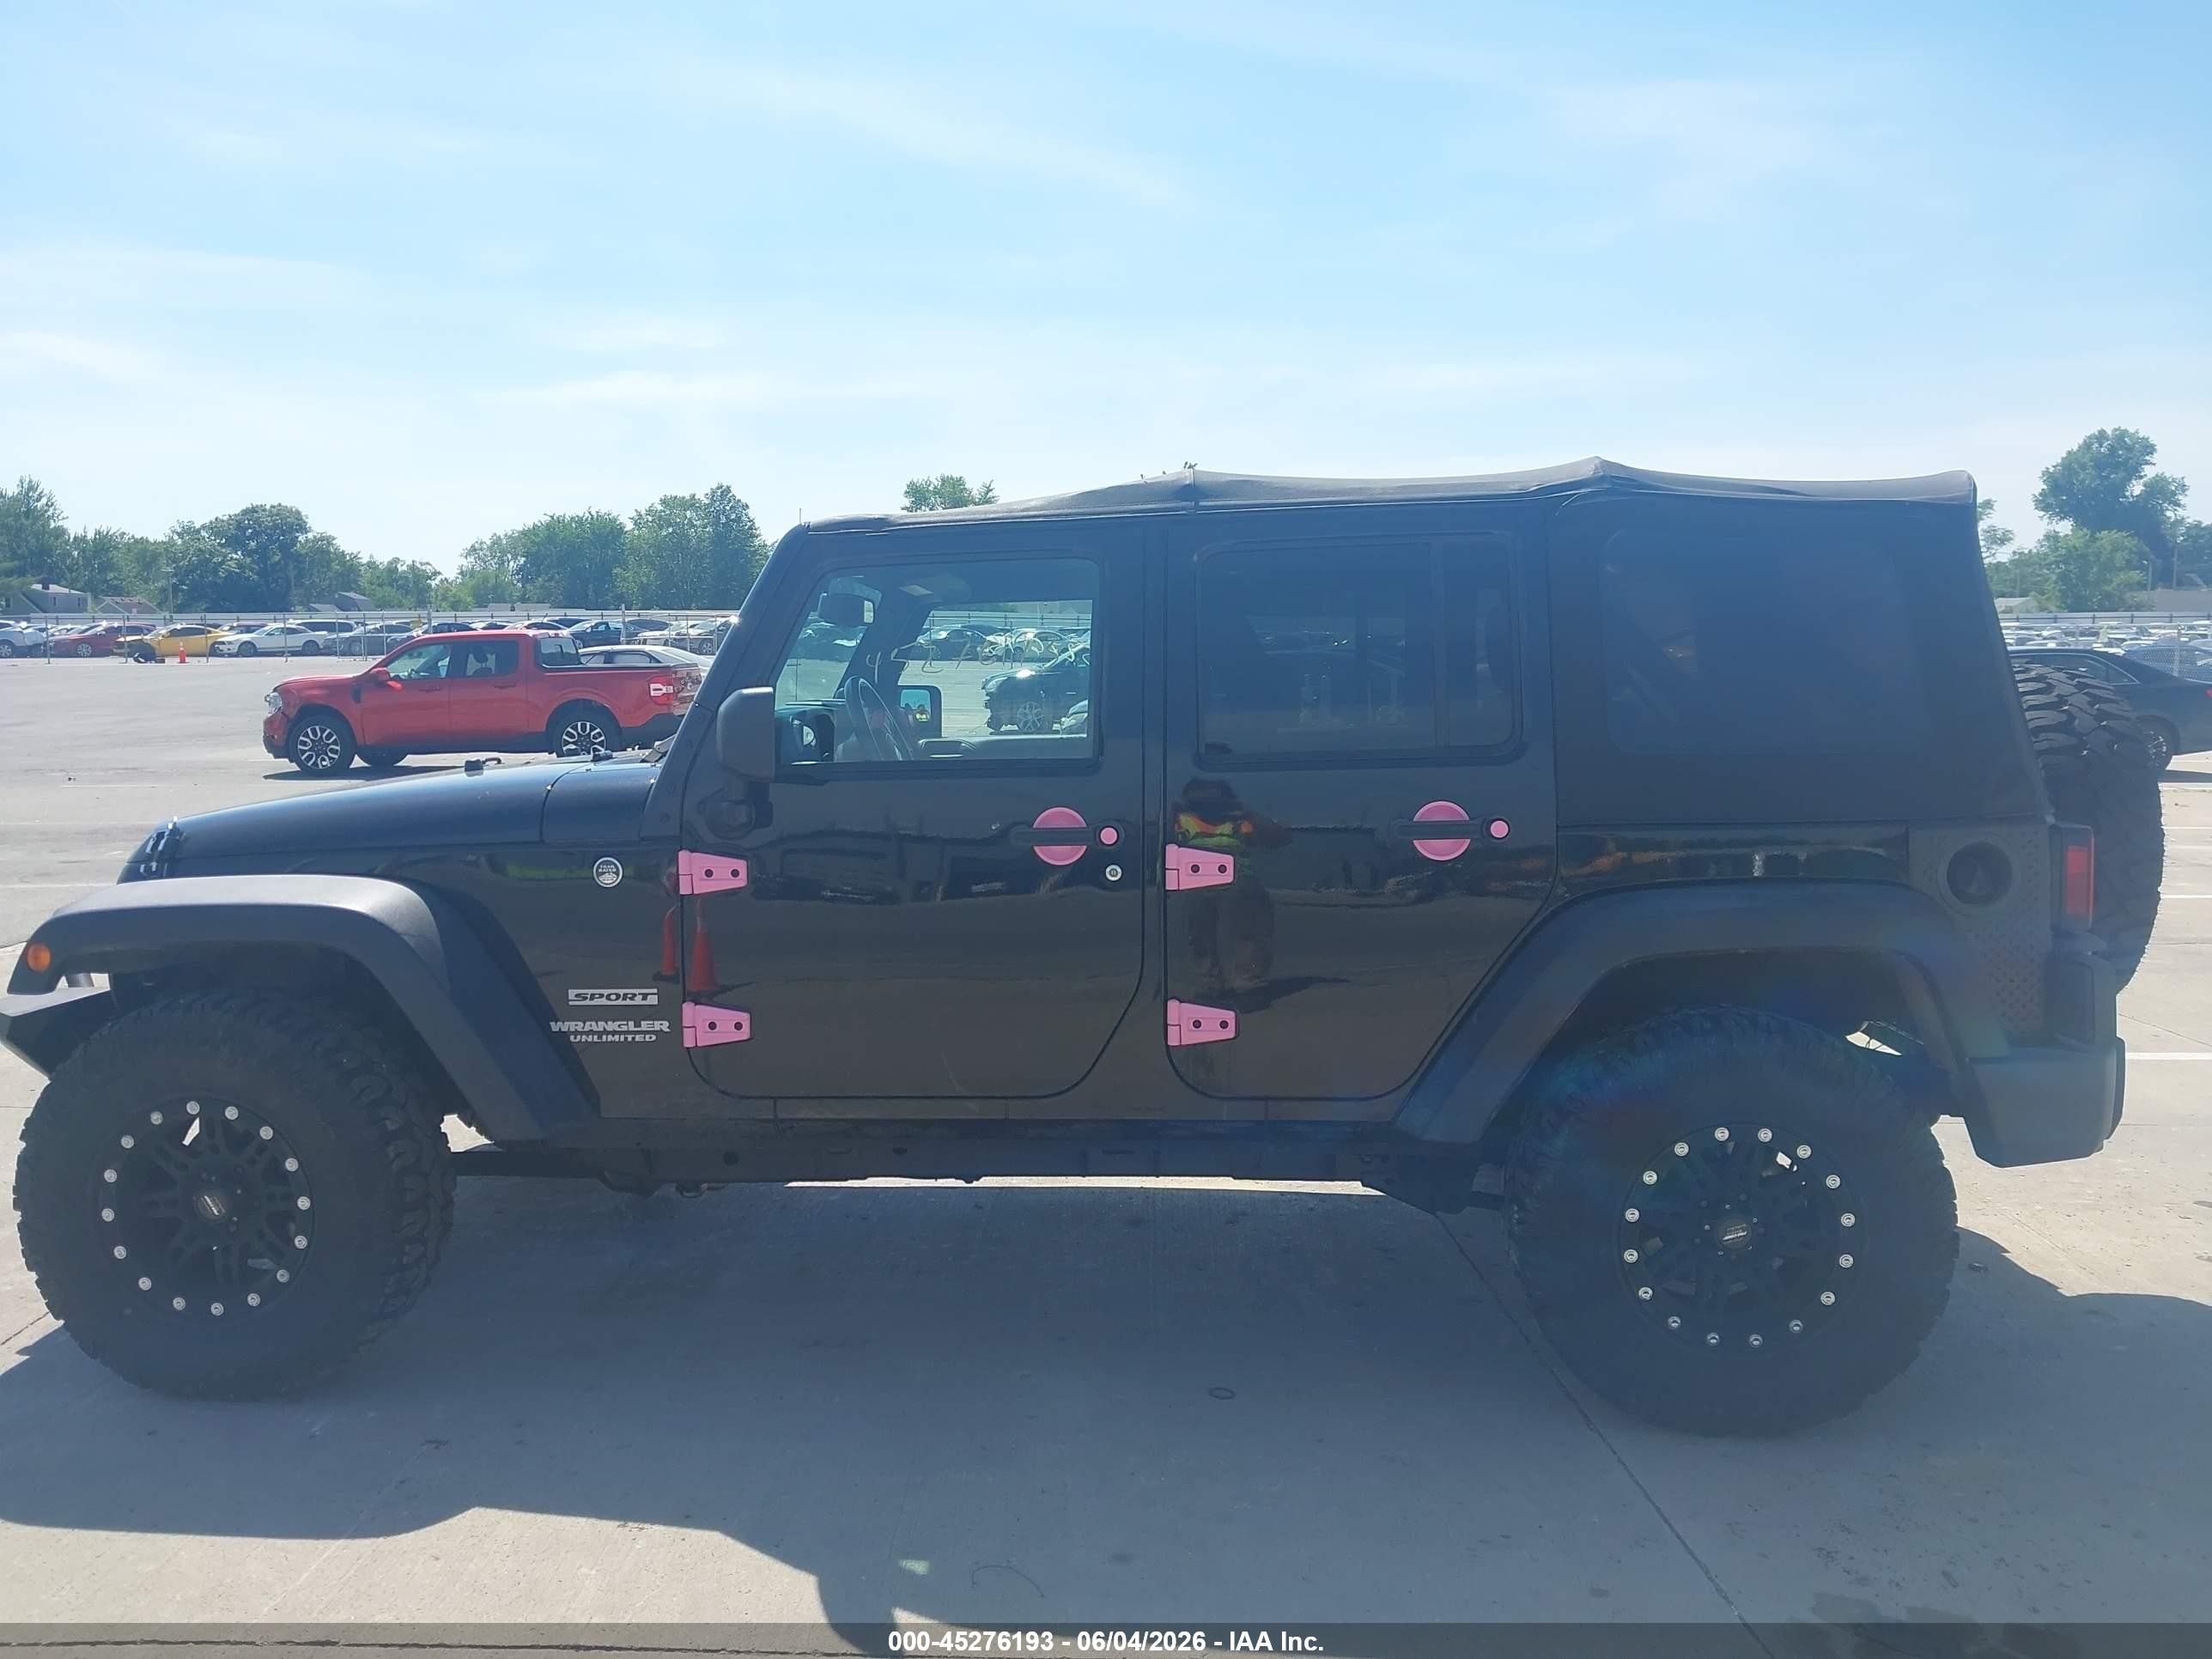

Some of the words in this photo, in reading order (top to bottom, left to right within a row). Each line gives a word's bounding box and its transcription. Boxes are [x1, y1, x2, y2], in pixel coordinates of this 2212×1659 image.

[570, 992, 657, 1002] SPORT
[549, 1020, 672, 1032] WRANGLER
[569, 1034, 657, 1042] UNLIMITED
